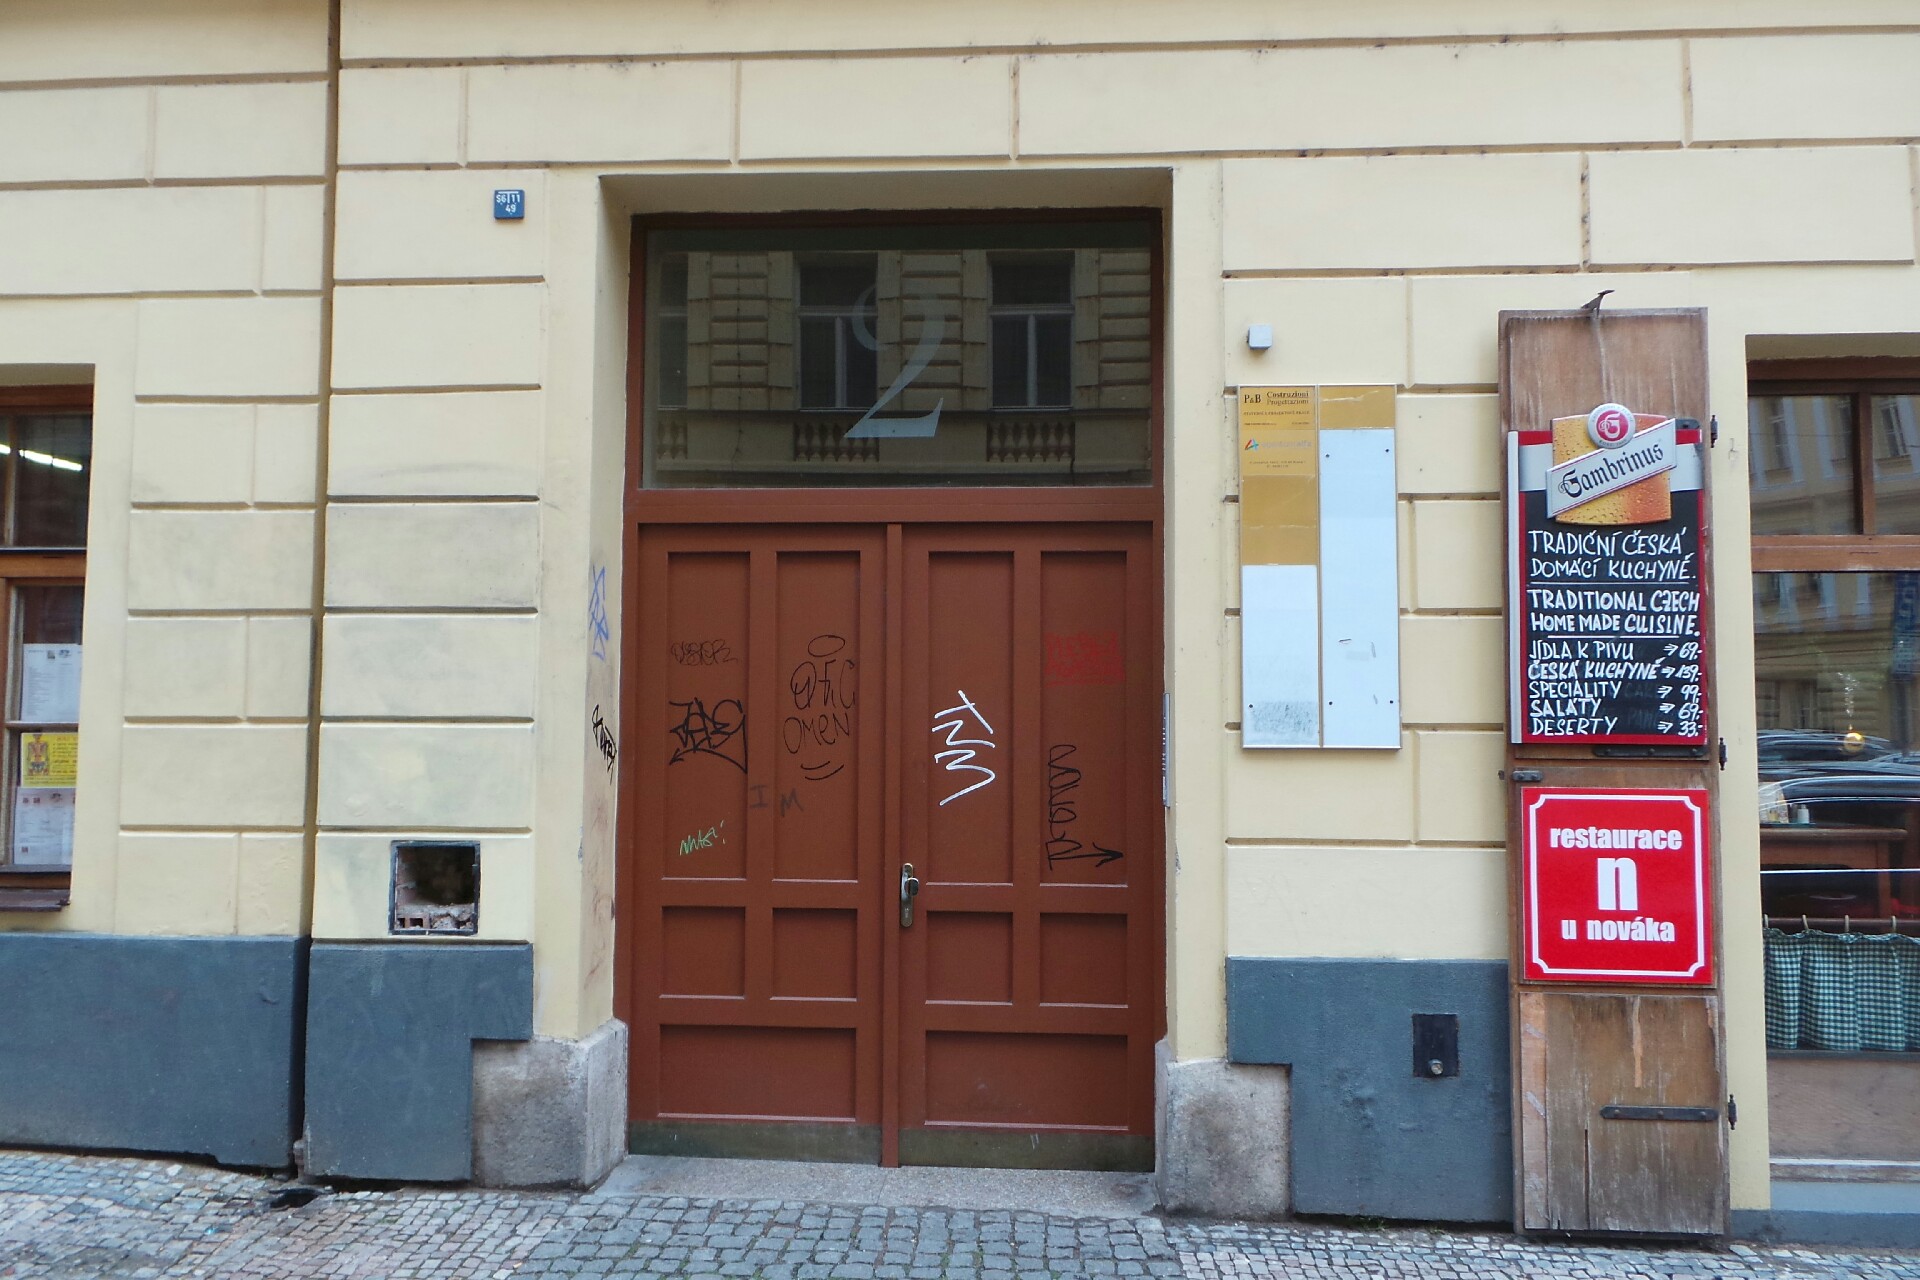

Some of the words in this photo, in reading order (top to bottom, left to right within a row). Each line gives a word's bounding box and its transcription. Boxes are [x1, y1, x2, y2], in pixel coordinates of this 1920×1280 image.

[843, 278, 946, 438] 2
[1244, 393, 1262, 404] P&B
[1557, 442, 1664, 499] Gambrinus
[1528, 529, 1623, 557] TRADIČNÍ
[1622, 526, 1687, 556] ČESKÁ
[1530, 557, 1602, 579] DOMÁCÍ
[1527, 588, 1647, 611] TRADITIONAL
[1650, 589, 1700, 612] CZECH
[1531, 612, 1576, 632] HOME
[1579, 613, 1621, 632] MADE
[1624, 614, 1701, 637] CUISINE.
[1528, 640, 1573, 660] JÍDLA
[1577, 640, 1589, 659] K
[1592, 641, 1634, 660] PIVU
[1527, 659, 1580, 680] ČESKÁ
[1528, 680, 1623, 699] SPECIALITY
[1529, 697, 1602, 718] SALÁTY
[1531, 716, 1618, 736] DESERTY
[1549, 826, 1683, 850] restaurace
[1596, 856, 1639, 911] n
[1561, 919, 1577, 941] u
[1587, 916, 1676, 942] nováka
